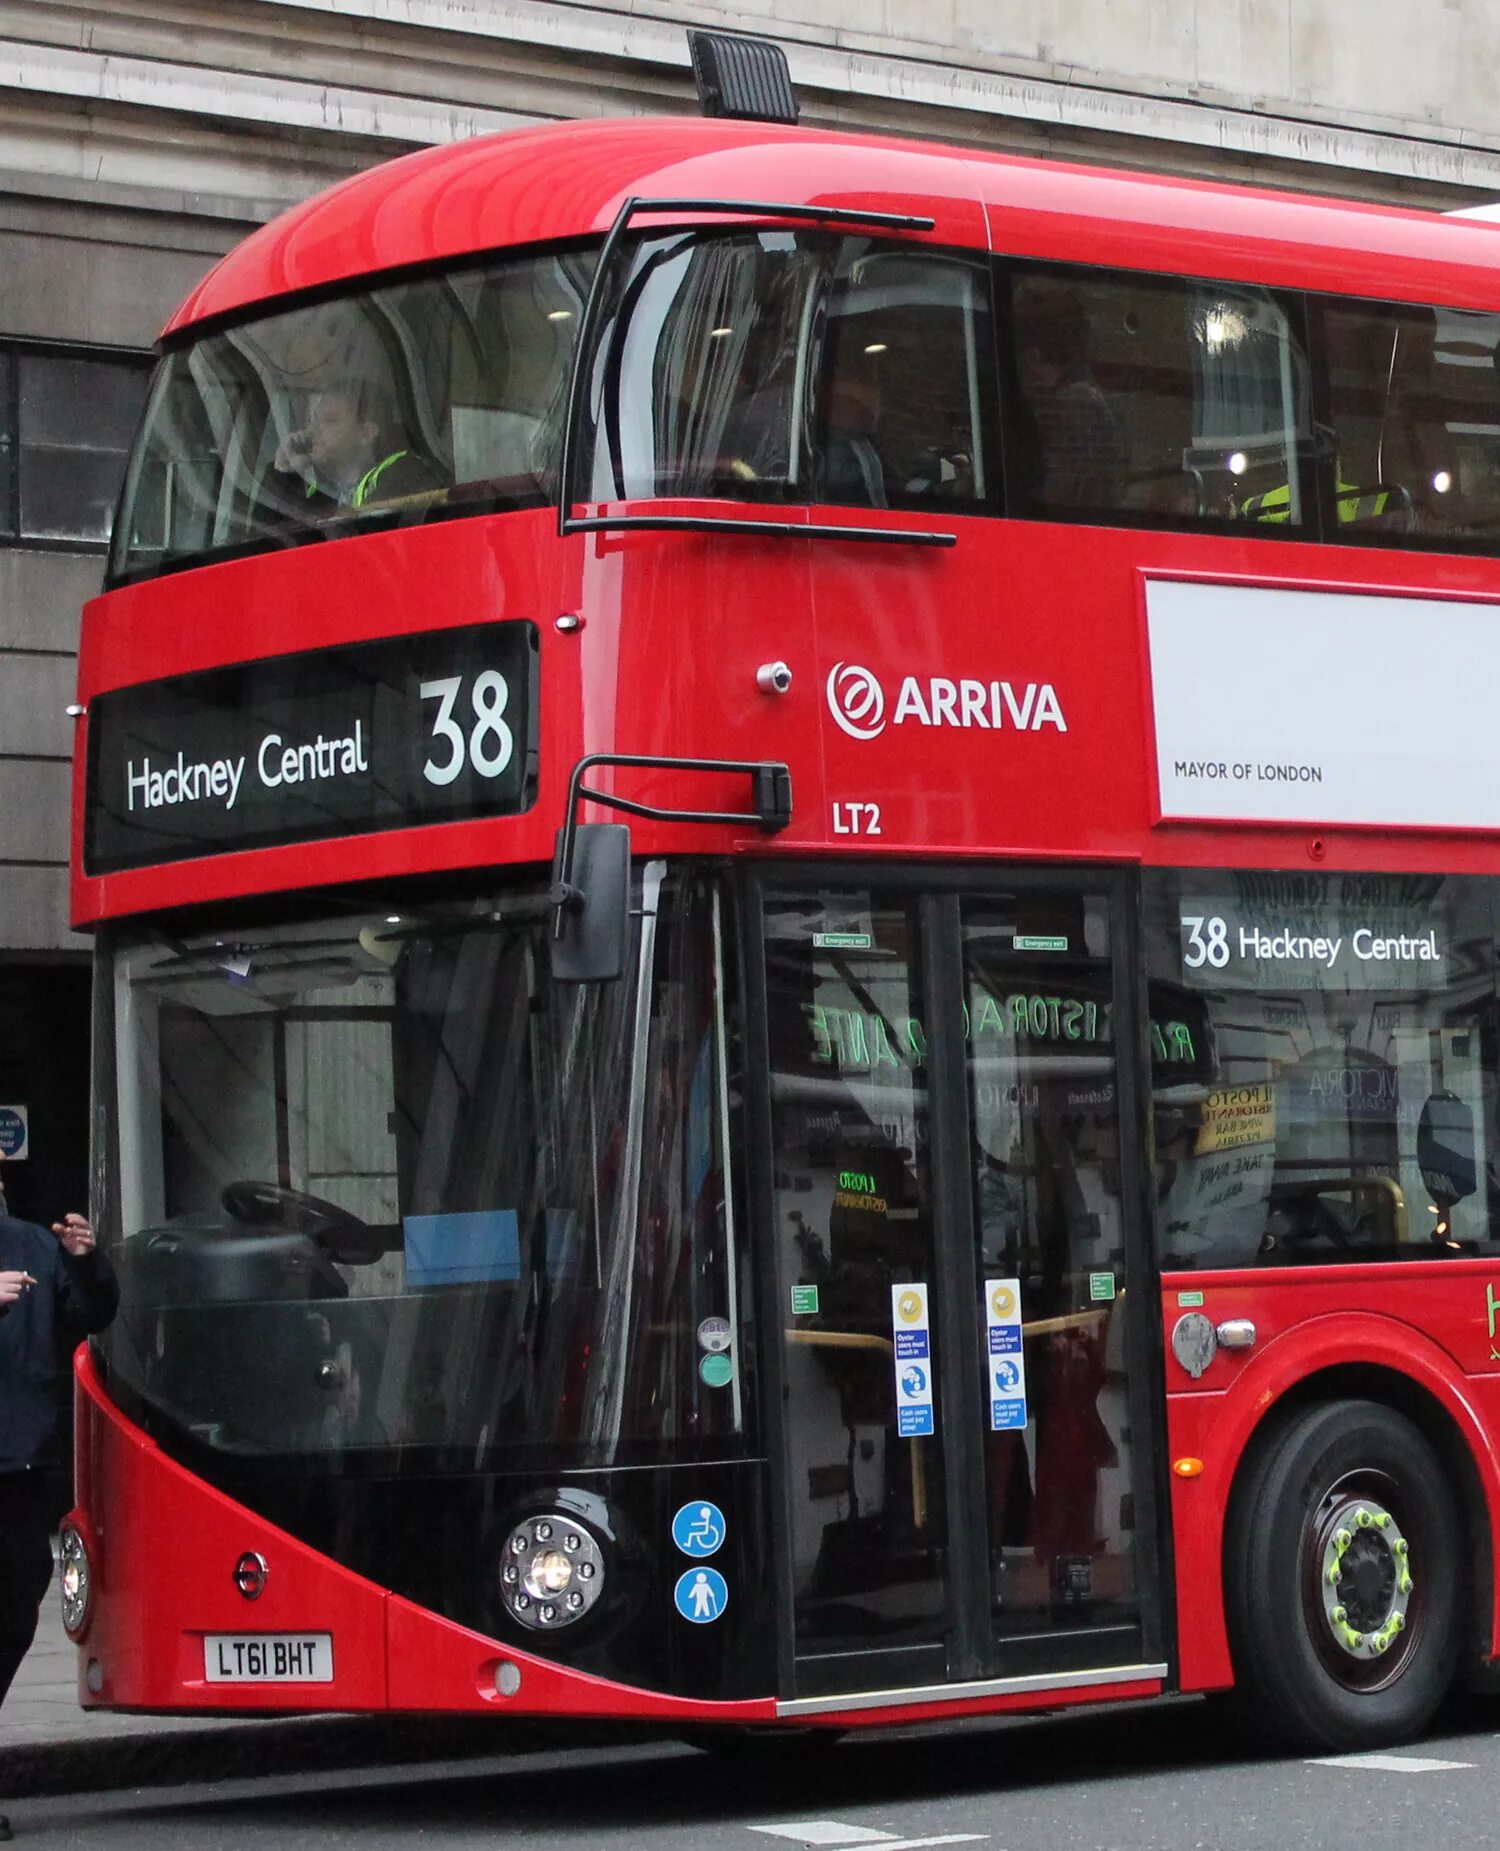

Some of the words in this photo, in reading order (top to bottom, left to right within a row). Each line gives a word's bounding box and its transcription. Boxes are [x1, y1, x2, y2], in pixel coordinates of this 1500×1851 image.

[893, 676, 1068, 732] ARRIVA
[420, 669, 513, 786] 38
[127, 752, 245, 811] Hackney
[257, 719, 368, 788] Central
[1174, 761, 1228, 779] MAYOR
[1232, 764, 1252, 780] OF
[1257, 764, 1322, 782] LONDON
[832, 802, 882, 835] LT2
[824, 936, 854, 946] Emergency
[1181, 917, 1230, 968] 38
[1239, 927, 1342, 968] Hackney
[1352, 928, 1440, 961] Central
[218, 1642, 267, 1675] LT61
[273, 1642, 316, 1675] BHT
